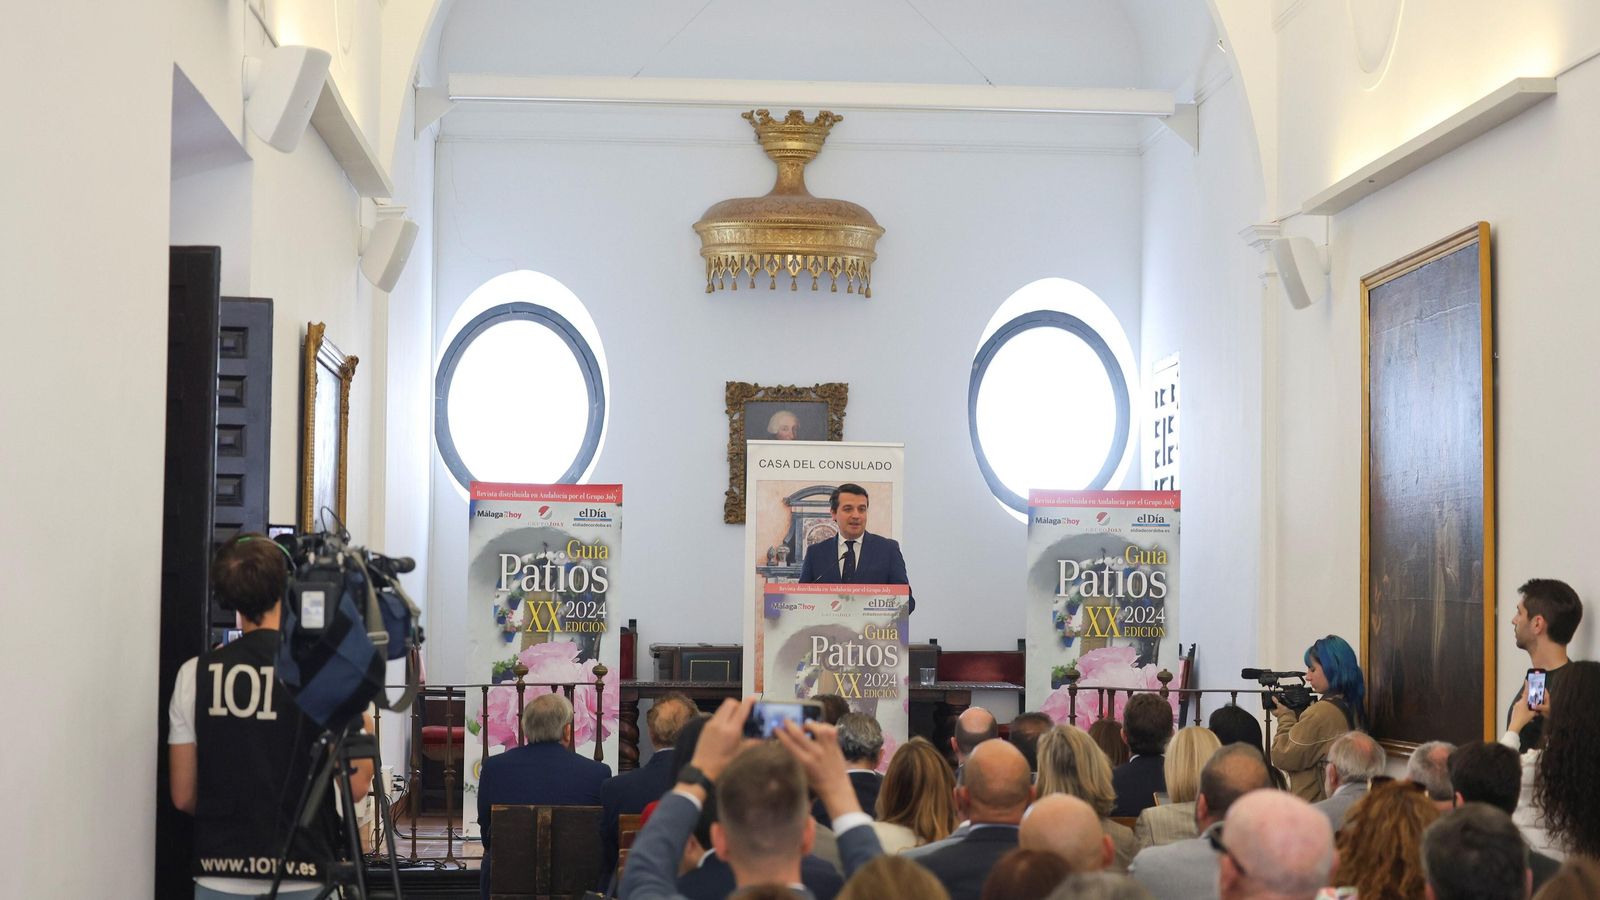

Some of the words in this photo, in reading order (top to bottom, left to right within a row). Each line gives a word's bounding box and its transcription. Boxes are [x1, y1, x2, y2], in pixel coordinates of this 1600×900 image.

[759, 459, 790, 469] CASA
[793, 460, 815, 469] DEL
[818, 460, 892, 471] CONSULADO
[476, 490, 498, 498] Revista
[605, 493, 617, 502] Joly
[1127, 499, 1136, 507] por
[1137, 497, 1143, 505] el
[1144, 499, 1162, 507] Grupo
[1164, 498, 1175, 507] Joly
[477, 510, 503, 519] Málaga
[509, 511, 521, 519] hoy
[1035, 517, 1061, 525] Málaga
[1067, 517, 1080, 525] hoy
[567, 539, 608, 560] Guía
[1125, 544, 1168, 565] Guía
[498, 552, 609, 593] Patios
[1057, 558, 1167, 598] Patios
[566, 601, 607, 619] 2024
[773, 602, 797, 611] Málaga
[802, 603, 815, 611] hoy
[1124, 606, 1165, 624] 2024
[526, 601, 563, 633] XX
[565, 619, 608, 632] EDICIÓN
[1085, 606, 1121, 638] XX
[865, 624, 898, 640] Guía
[1124, 624, 1166, 638] EDICIÓN
[810, 634, 898, 667] Patios
[833, 672, 862, 699] XX
[864, 673, 897, 687] 2024
[208, 663, 277, 720] 101
[864, 687, 897, 698] EDICIÓN
[200, 857, 317, 876] www.101v.es
